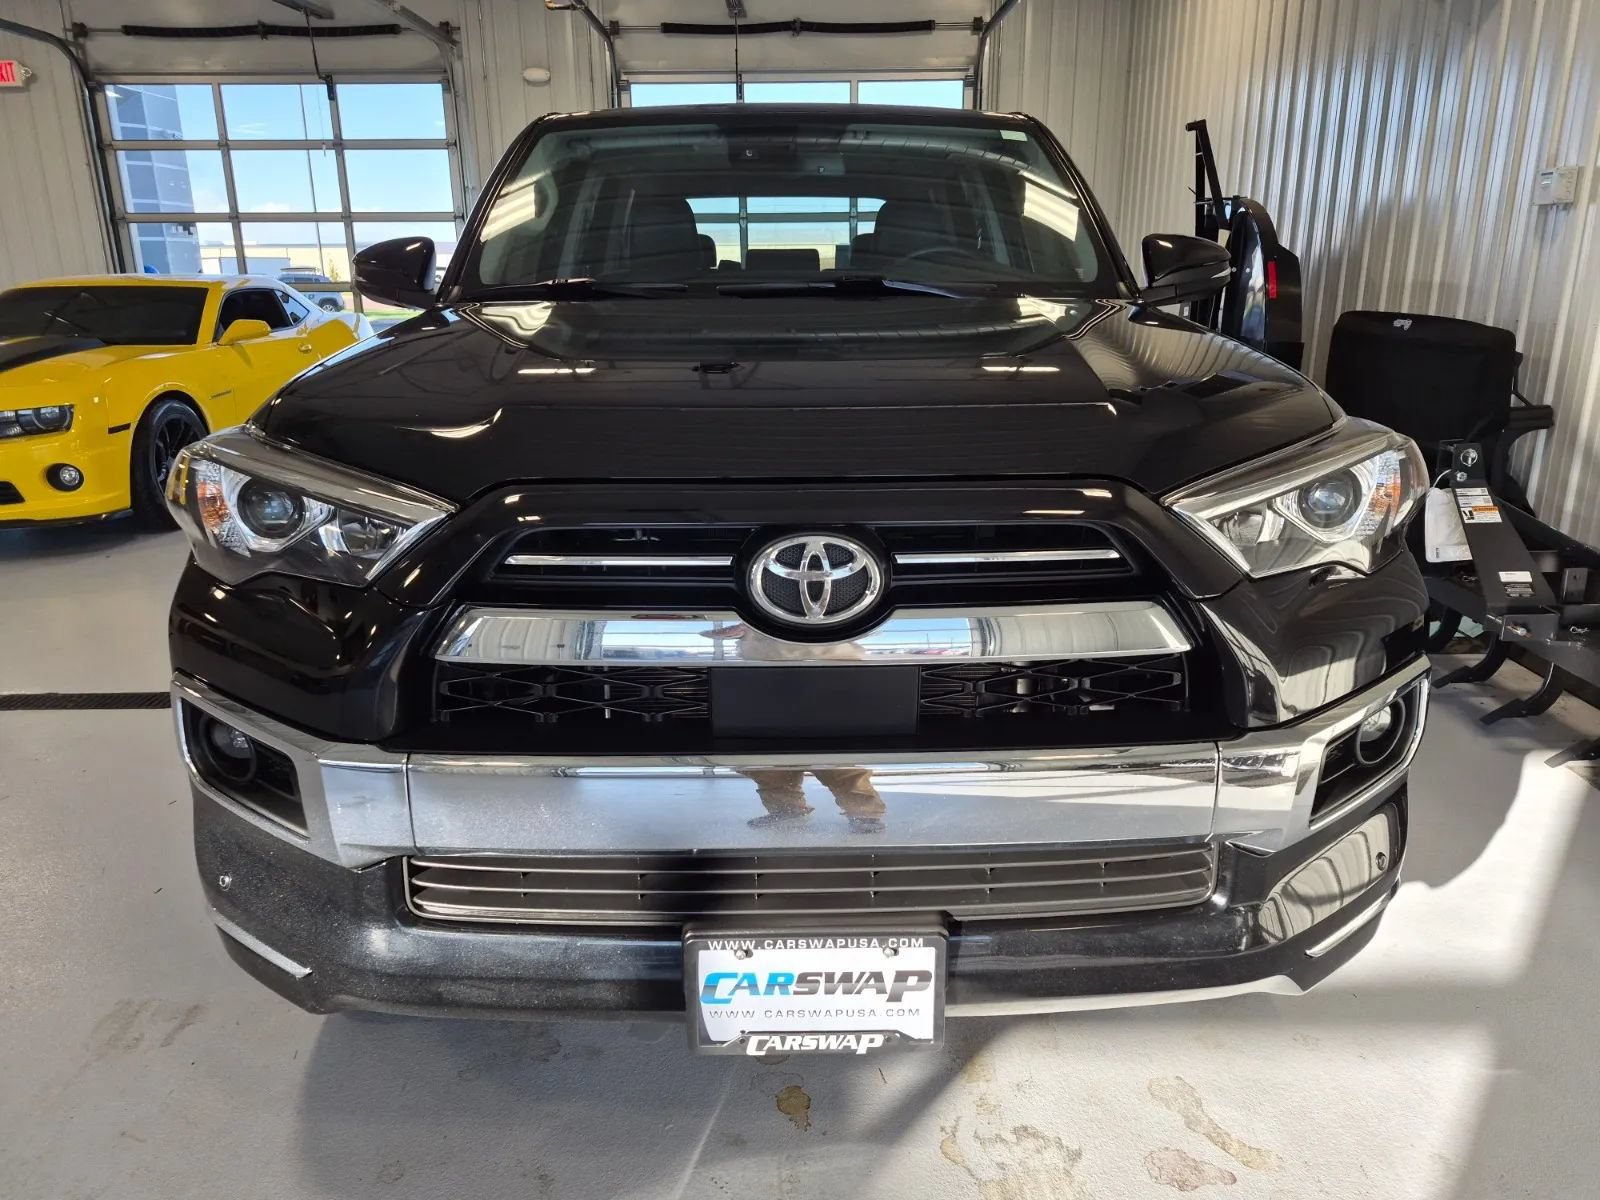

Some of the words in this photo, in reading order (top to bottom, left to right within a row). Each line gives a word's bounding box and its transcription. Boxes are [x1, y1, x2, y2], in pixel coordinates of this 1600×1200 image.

[0, 62, 15, 82] XIT
[707, 938, 924, 950] WWW.CARSWAPUSA.COM
[700, 970, 933, 1004] CARSWAP
[709, 1008, 920, 1019] WWWCARSWAPUSA.COM
[746, 1034, 884, 1055] CARSWAP
